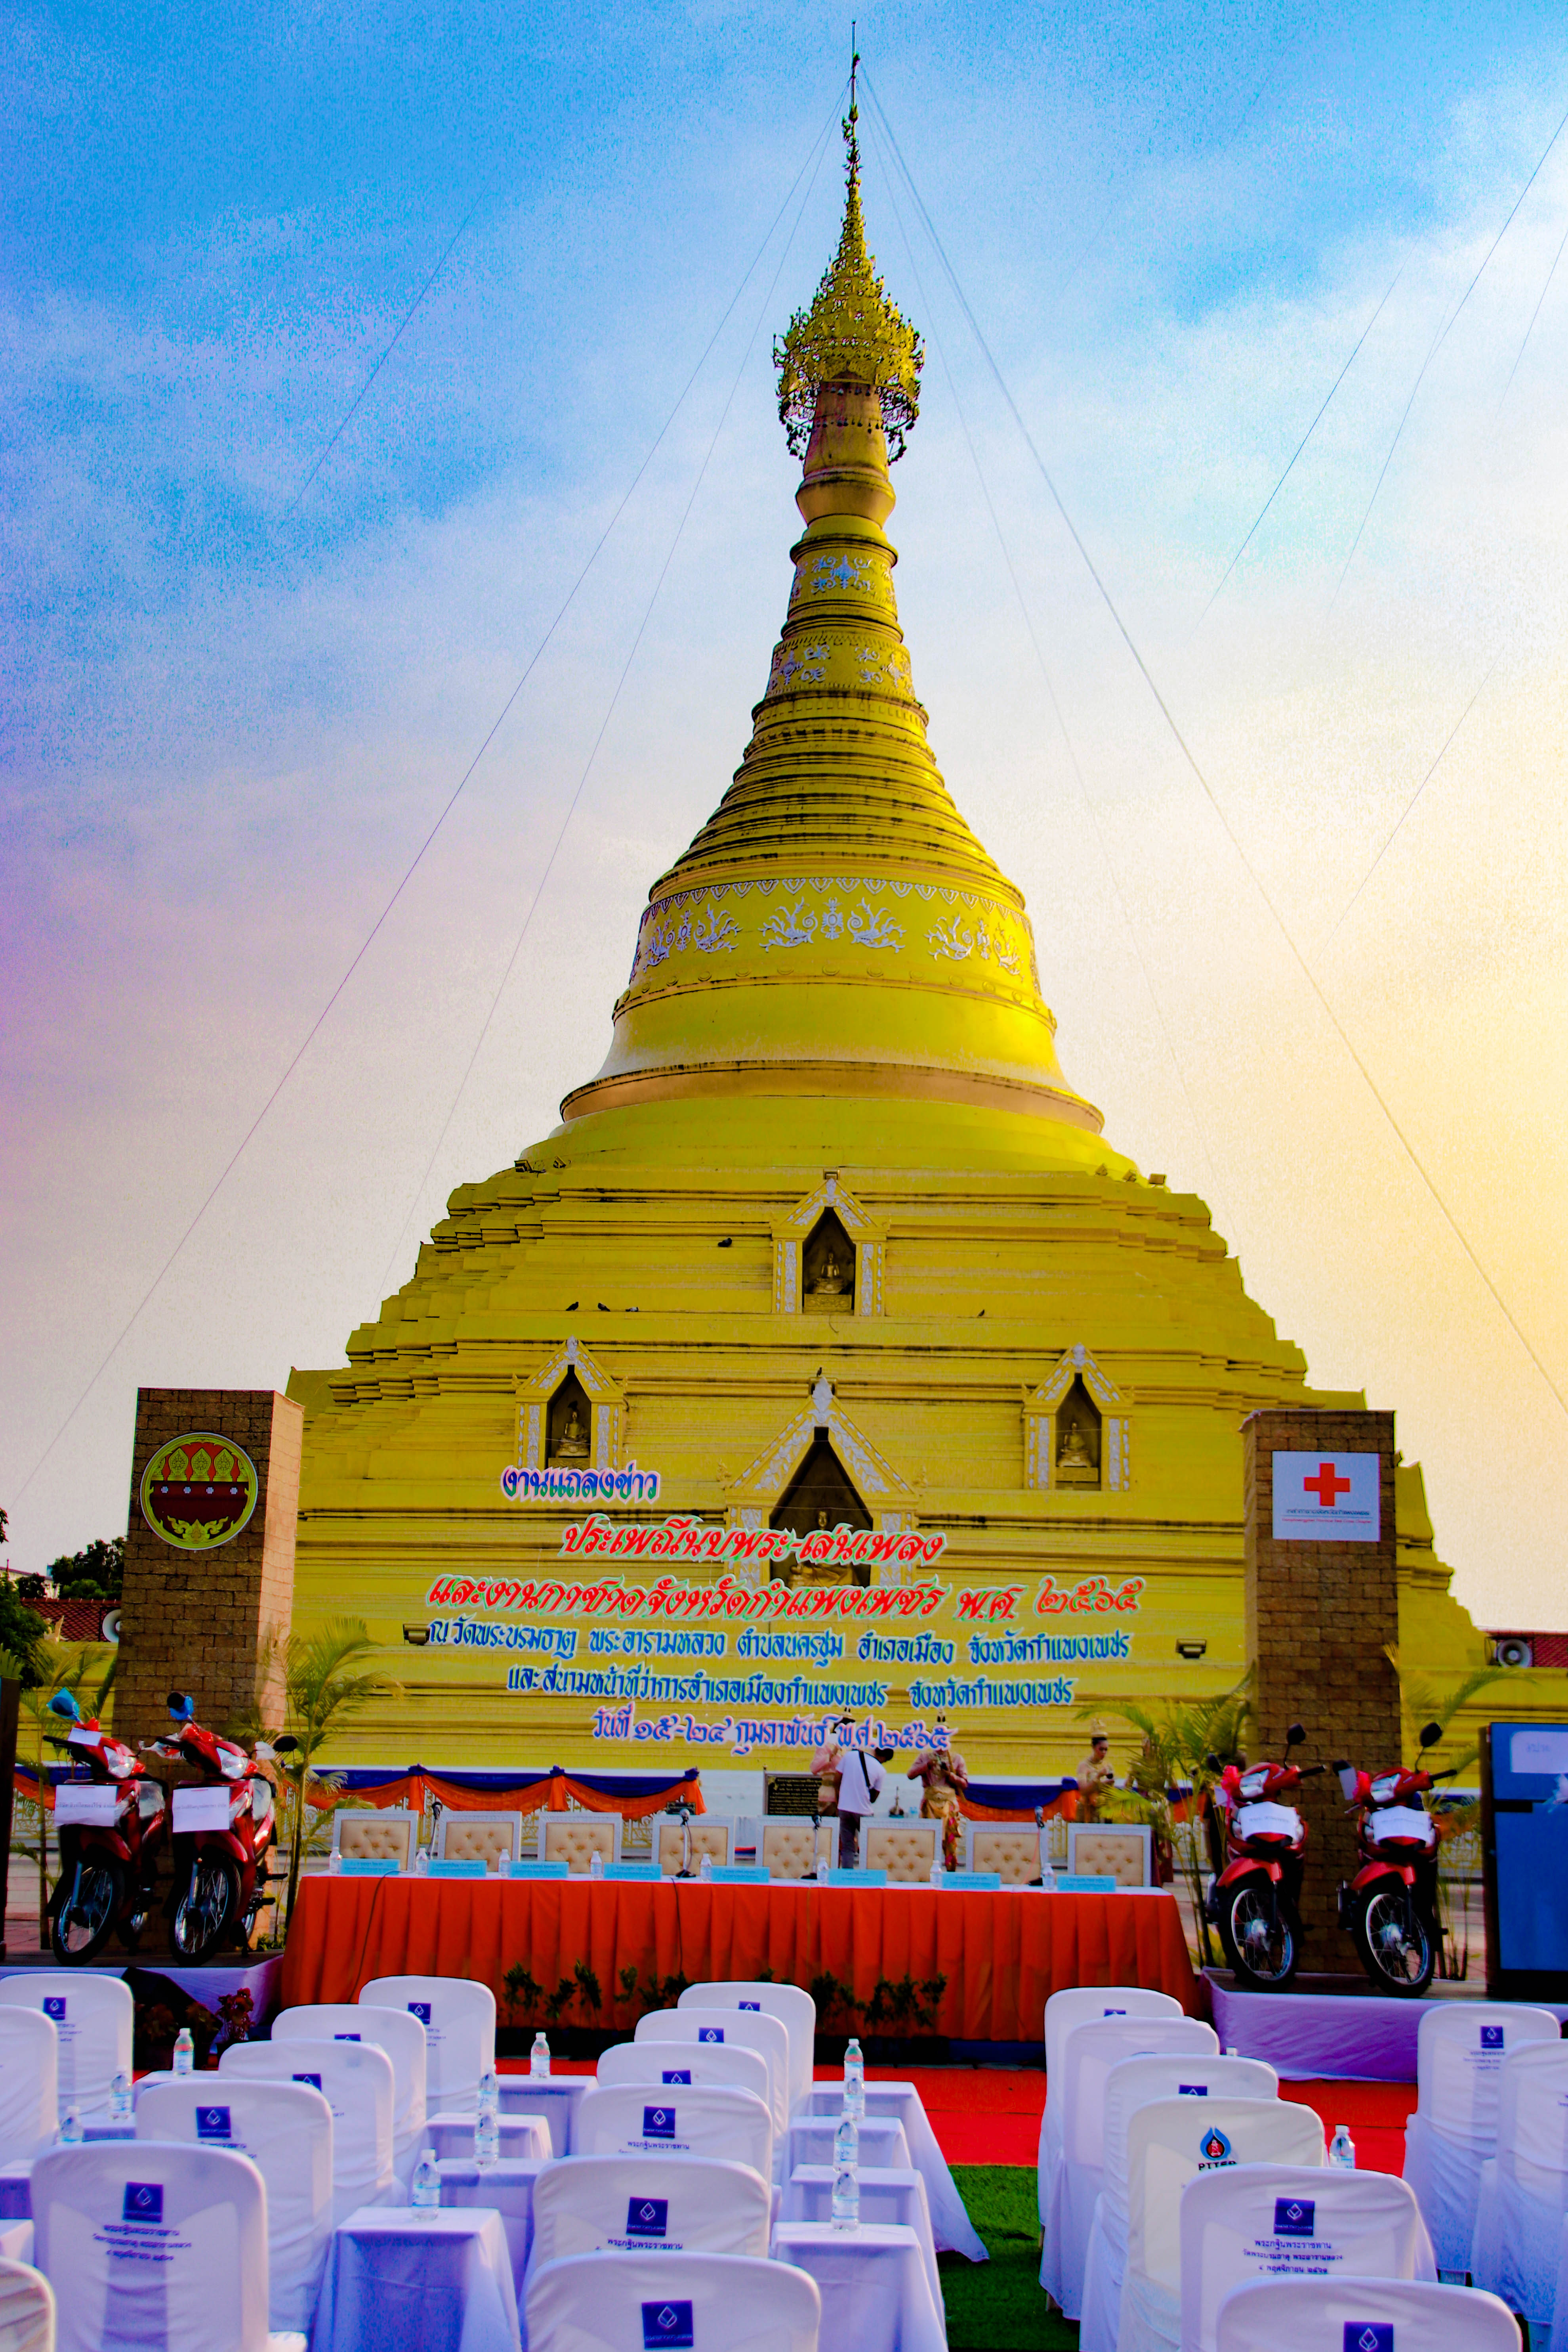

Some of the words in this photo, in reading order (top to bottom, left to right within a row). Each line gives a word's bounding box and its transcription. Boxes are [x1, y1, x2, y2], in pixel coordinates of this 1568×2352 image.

[504, 1463, 658, 1501] งานแถลงข่าว
[565, 1516, 943, 1562] ประเพณีนบพระ-เล่นเพลง
[429, 1577, 946, 1616] และงานกาชาดจังหวัดกำแพงเพชร
[1036, 1578, 1143, 1614] ๒๕๖๕
[429, 1621, 449, 1643] ณ
[452, 1613, 577, 1659] วัดพระบรมธาตุ
[589, 1627, 725, 1656] พระอารามหลวง
[737, 1628, 844, 1667] ตำบลนครชุม
[858, 1631, 954, 1664] อำเภอเมือง
[969, 1629, 1131, 1663] จังหวัดกำแพงเพชร
[508, 1668, 540, 1690] และ
[909, 1674, 1074, 1707] จังหวัดกำแพงเพชร
[593, 1703, 633, 1738] วันที่
[634, 1715, 732, 1742] ๑๕-๒๔
[1255, 2238, 1331, 2250] พระกฐินพระราชทาน
